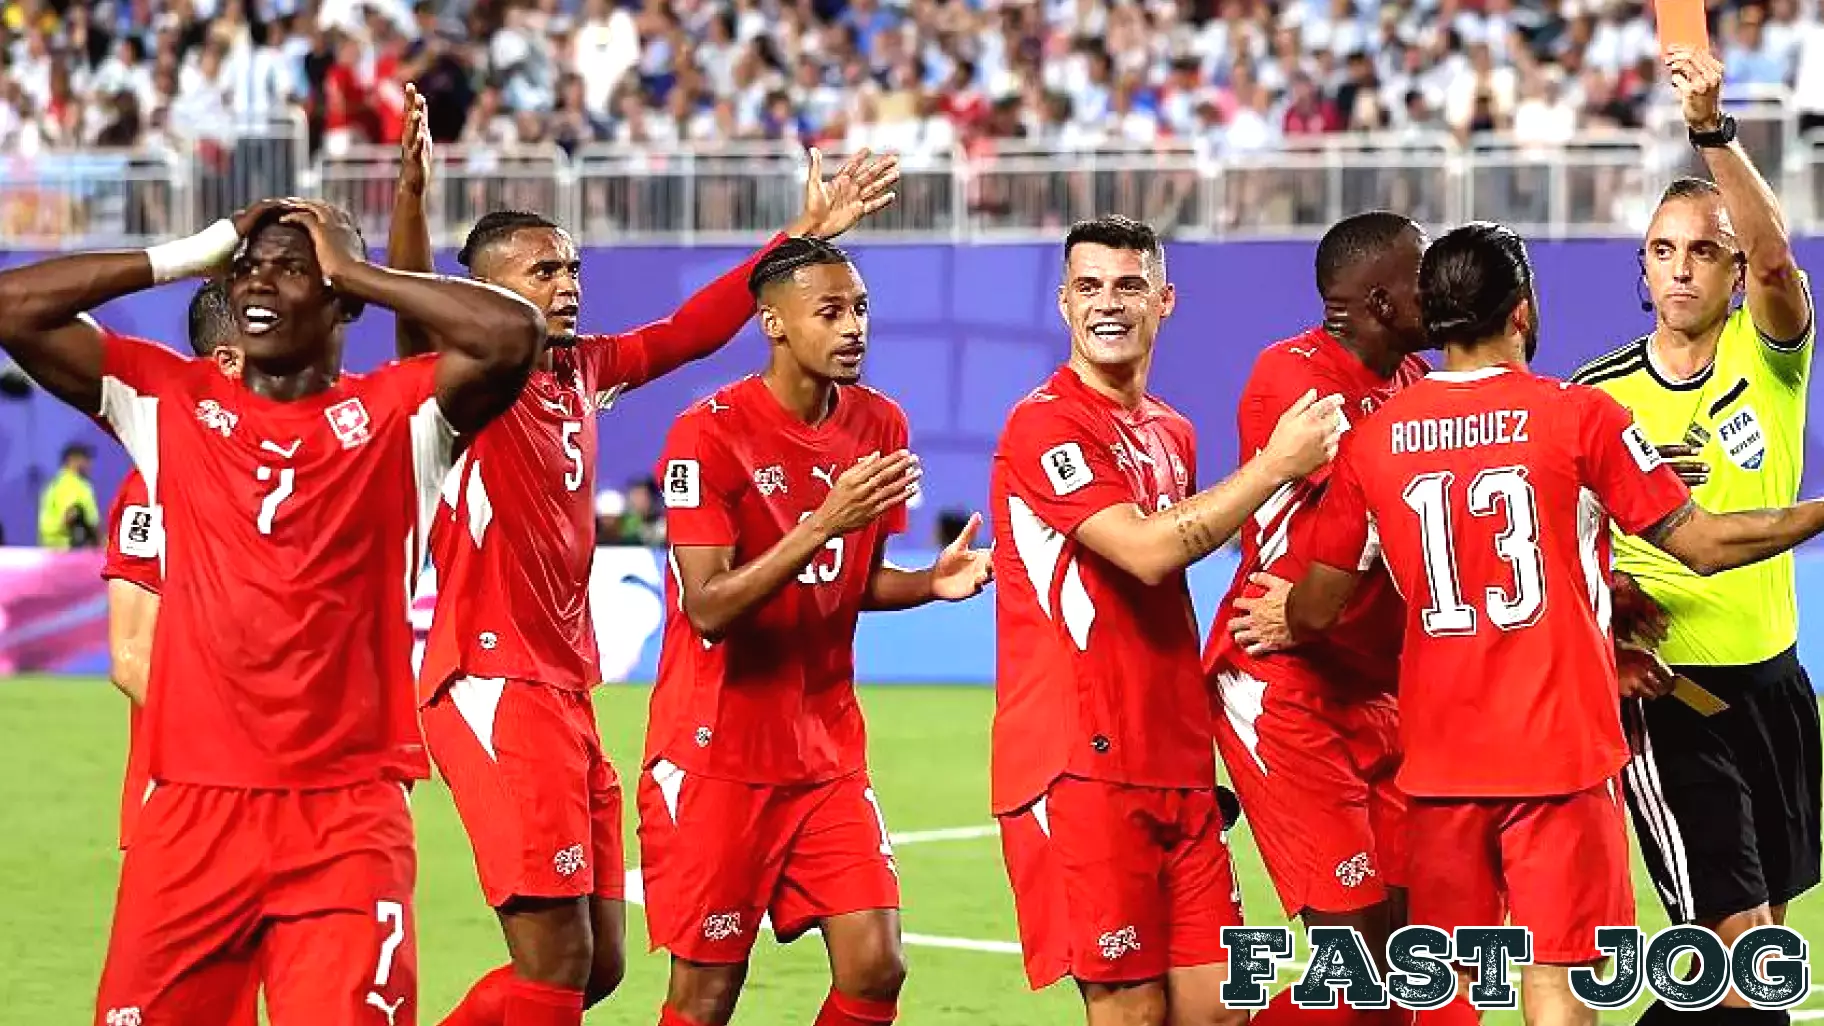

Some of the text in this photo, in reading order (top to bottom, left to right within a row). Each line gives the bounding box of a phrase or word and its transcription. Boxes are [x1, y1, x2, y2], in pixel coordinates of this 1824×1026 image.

[562, 422, 584, 491] 5
[1391, 410, 1529, 454] RODRIGUEZ
[1719, 412, 1754, 441] FIFA
[257, 466, 294, 535] 7
[1402, 465, 1548, 637] 13
[374, 901, 403, 985] 7
